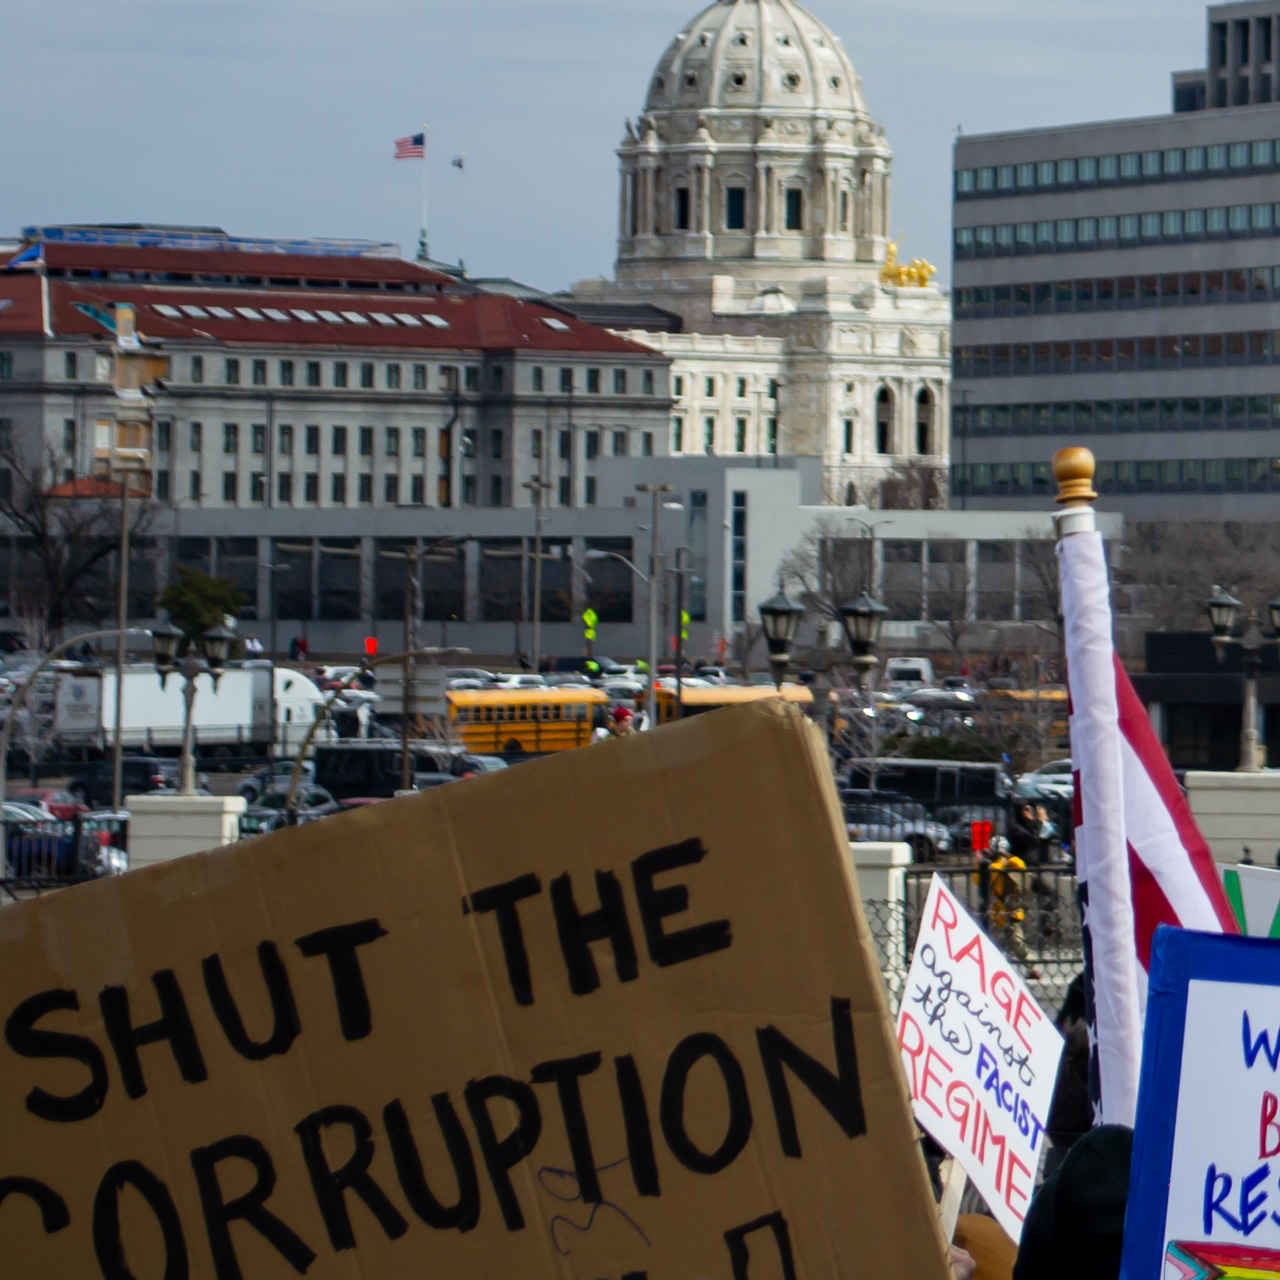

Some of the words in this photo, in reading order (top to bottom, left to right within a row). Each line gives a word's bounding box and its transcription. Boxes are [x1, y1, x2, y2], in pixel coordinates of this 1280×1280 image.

[3, 916, 390, 1121] SHUT
[461, 836, 732, 1006] THE
[919, 943, 1036, 1087] against
[930, 887, 1042, 1055] RAGE
[898, 1010, 1033, 1224] REGIME
[911, 982, 973, 1056] the
[975, 1041, 1046, 1152] FACIST
